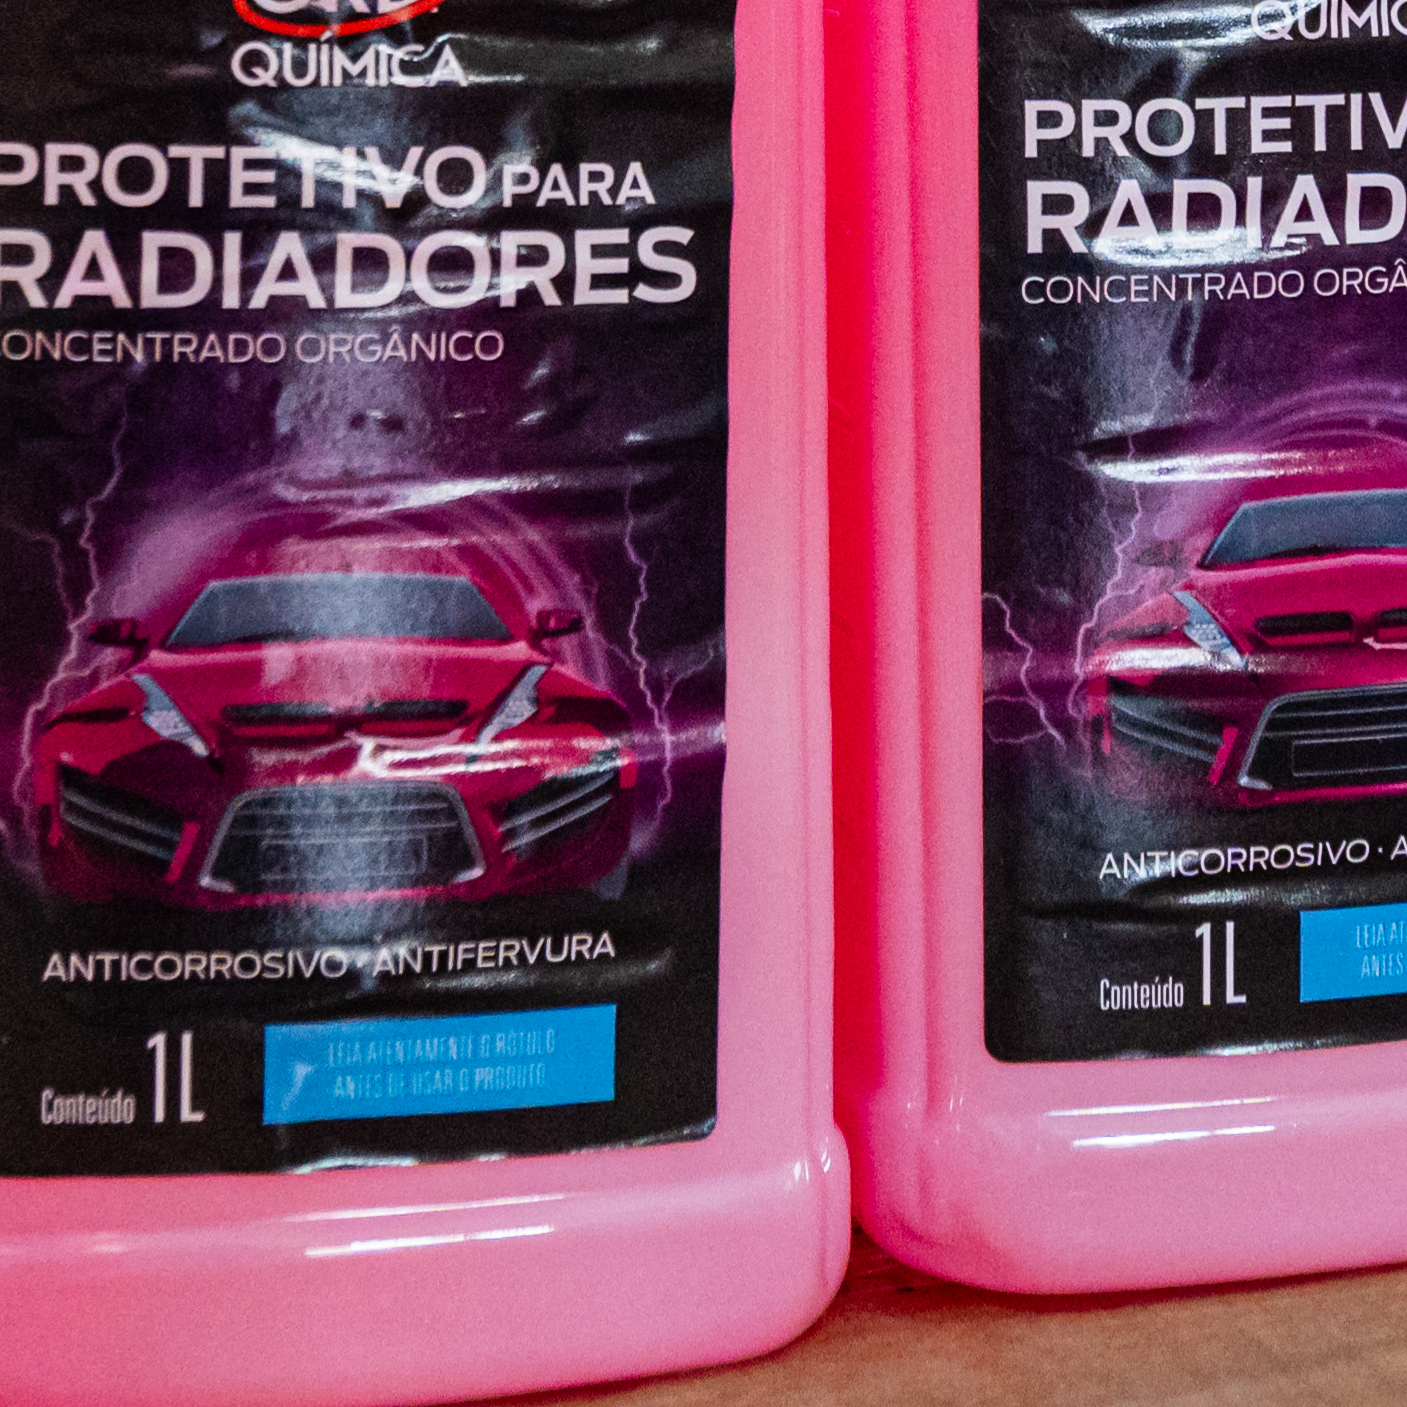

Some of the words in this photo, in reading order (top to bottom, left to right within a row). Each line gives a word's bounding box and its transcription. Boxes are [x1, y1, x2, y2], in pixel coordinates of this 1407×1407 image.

[230, 31, 470, 89] QUÍMICA
[502, 161, 656, 208] PARA
[1020, 270, 1305, 305] CONCENTRADO
[295, 326, 506, 363] ORGÂNICO
[1099, 839, 1370, 879] ANTICORROSIVO
[42, 949, 348, 983] ANTICORROSIVO
[372, 932, 616, 977] ANTIFERVURA
[1356, 923, 1386, 948] LEIA
[1099, 976, 1184, 1010] Conteúdo
[1194, 920, 1247, 1006] 1L
[41, 1087, 136, 1125] Conteúdo
[146, 1030, 205, 1124] 1L
